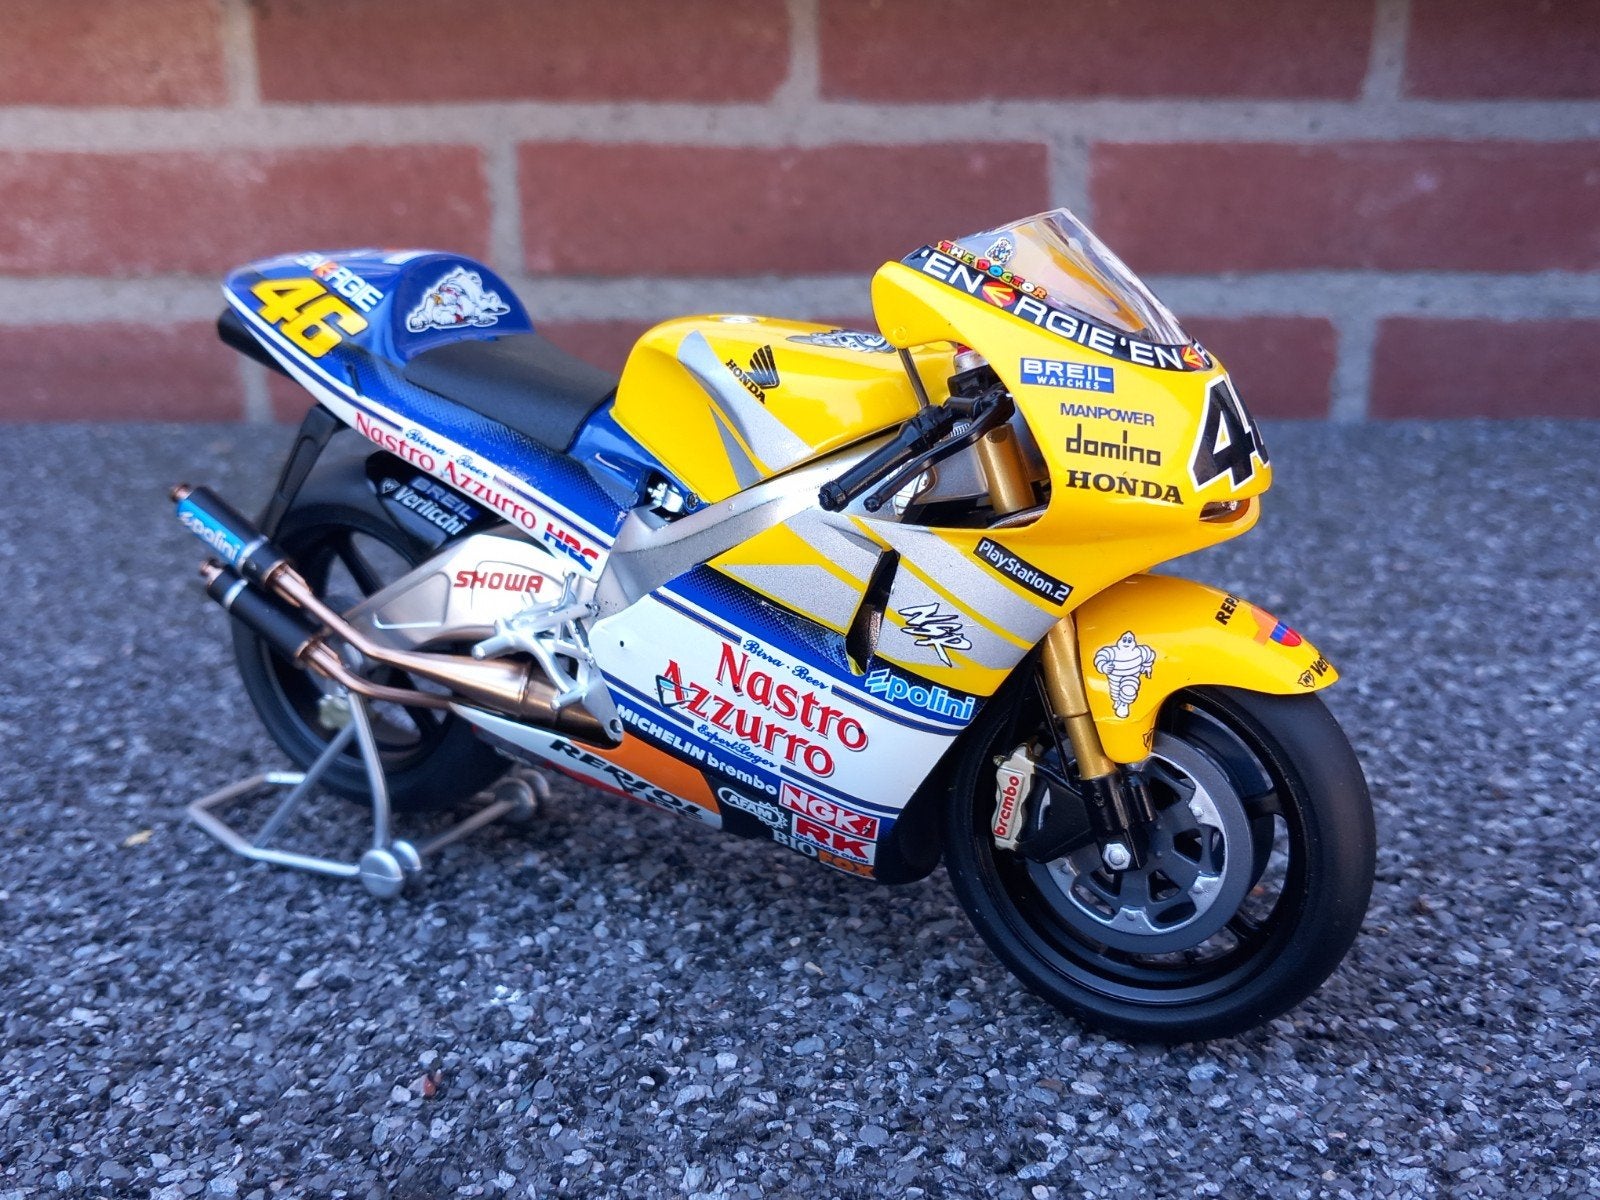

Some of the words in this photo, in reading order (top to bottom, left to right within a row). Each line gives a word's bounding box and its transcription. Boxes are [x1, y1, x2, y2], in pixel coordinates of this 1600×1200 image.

[938, 240, 976, 264] THE
[974, 258, 1048, 299] DOCTOR
[251, 277, 368, 358] 46
[725, 359, 766, 405] HONDA
[1023, 360, 1111, 383] BREIL
[1036, 375, 1100, 391] WATCHES
[1060, 402, 1155, 426] MANPOWER
[1187, 374, 1271, 493] 4
[1065, 423, 1161, 467] domino
[356, 412, 435, 472] Nastro
[441, 460, 537, 530] Azzurro
[1066, 470, 1184, 505] HONDA
[543, 522, 599, 572] HRC
[453, 570, 544, 594] SHOWA
[743, 639, 785, 669] Birra
[792, 665, 830, 690] Beer
[663, 659, 834, 778] Azzurro
[715, 642, 869, 751] Nastro
[887, 674, 976, 721] polini
[617, 703, 705, 760] MICHELIN
[707, 752, 778, 795] brembo
[728, 794, 774, 820] AFAM
[783, 785, 861, 833] NGK
[994, 776, 1020, 837] brembo
[772, 829, 817, 858] BIO
[796, 817, 870, 858] RK
